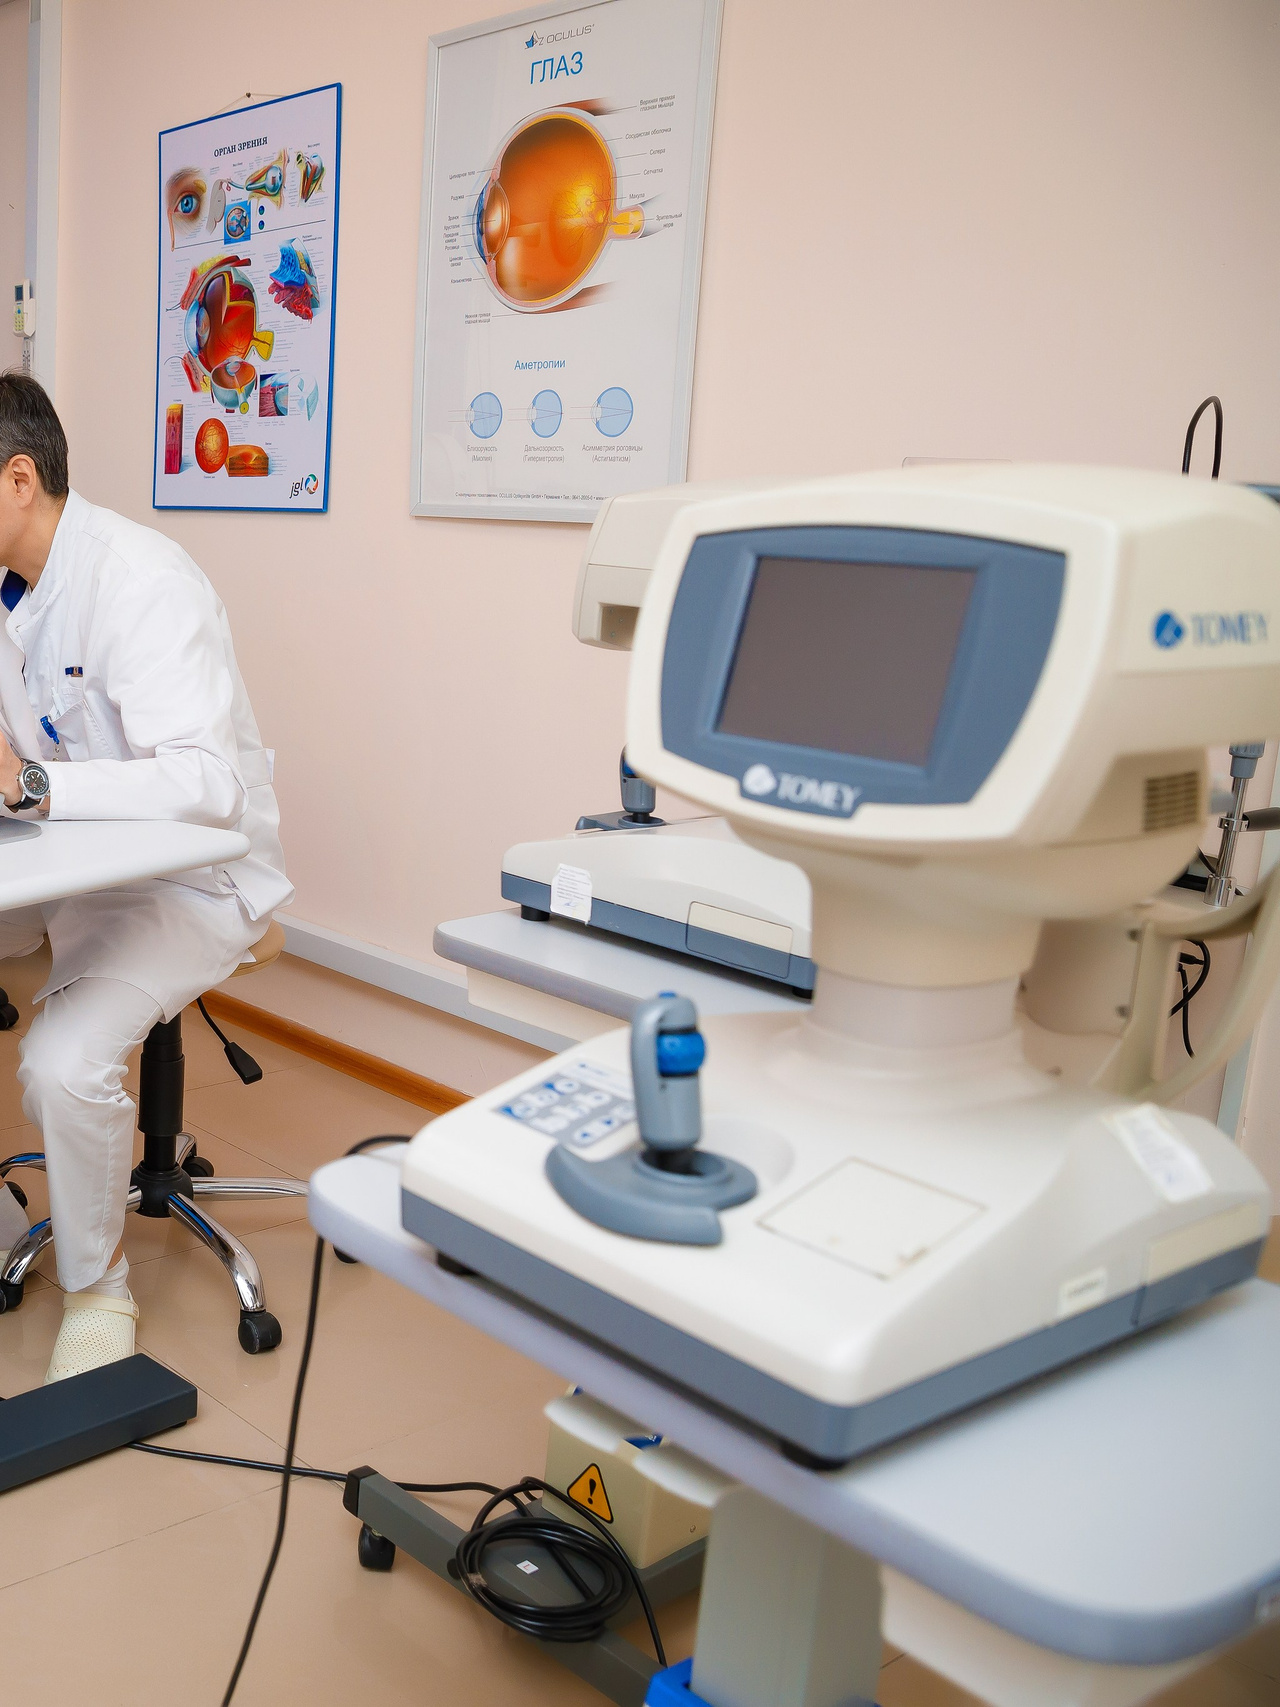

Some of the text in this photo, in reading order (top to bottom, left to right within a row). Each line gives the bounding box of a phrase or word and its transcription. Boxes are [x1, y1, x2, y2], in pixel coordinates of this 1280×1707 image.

[546, 24, 593, 44] OCULUS
[530, 50, 584, 85] ГЛАЗ
[625, 127, 672, 140] Сосудистая оболочка
[213, 136, 268, 158] ОРГАН ЗРЕНИЯ
[649, 148, 666, 156] Склера
[628, 192, 646, 200] Макула
[513, 359, 566, 371] Аметропии
[466, 444, 498, 453] Близорукость
[524, 444, 565, 453] Дальнозоркость
[581, 444, 644, 453] Асимметрия роговицы
[522, 454, 565, 464] (Гиперметропия)
[591, 454, 631, 464] (Астигматизм)
[288, 477, 304, 499] jgl
[1191, 611, 1269, 646] TOMEY
[777, 772, 862, 813] TOMEY
